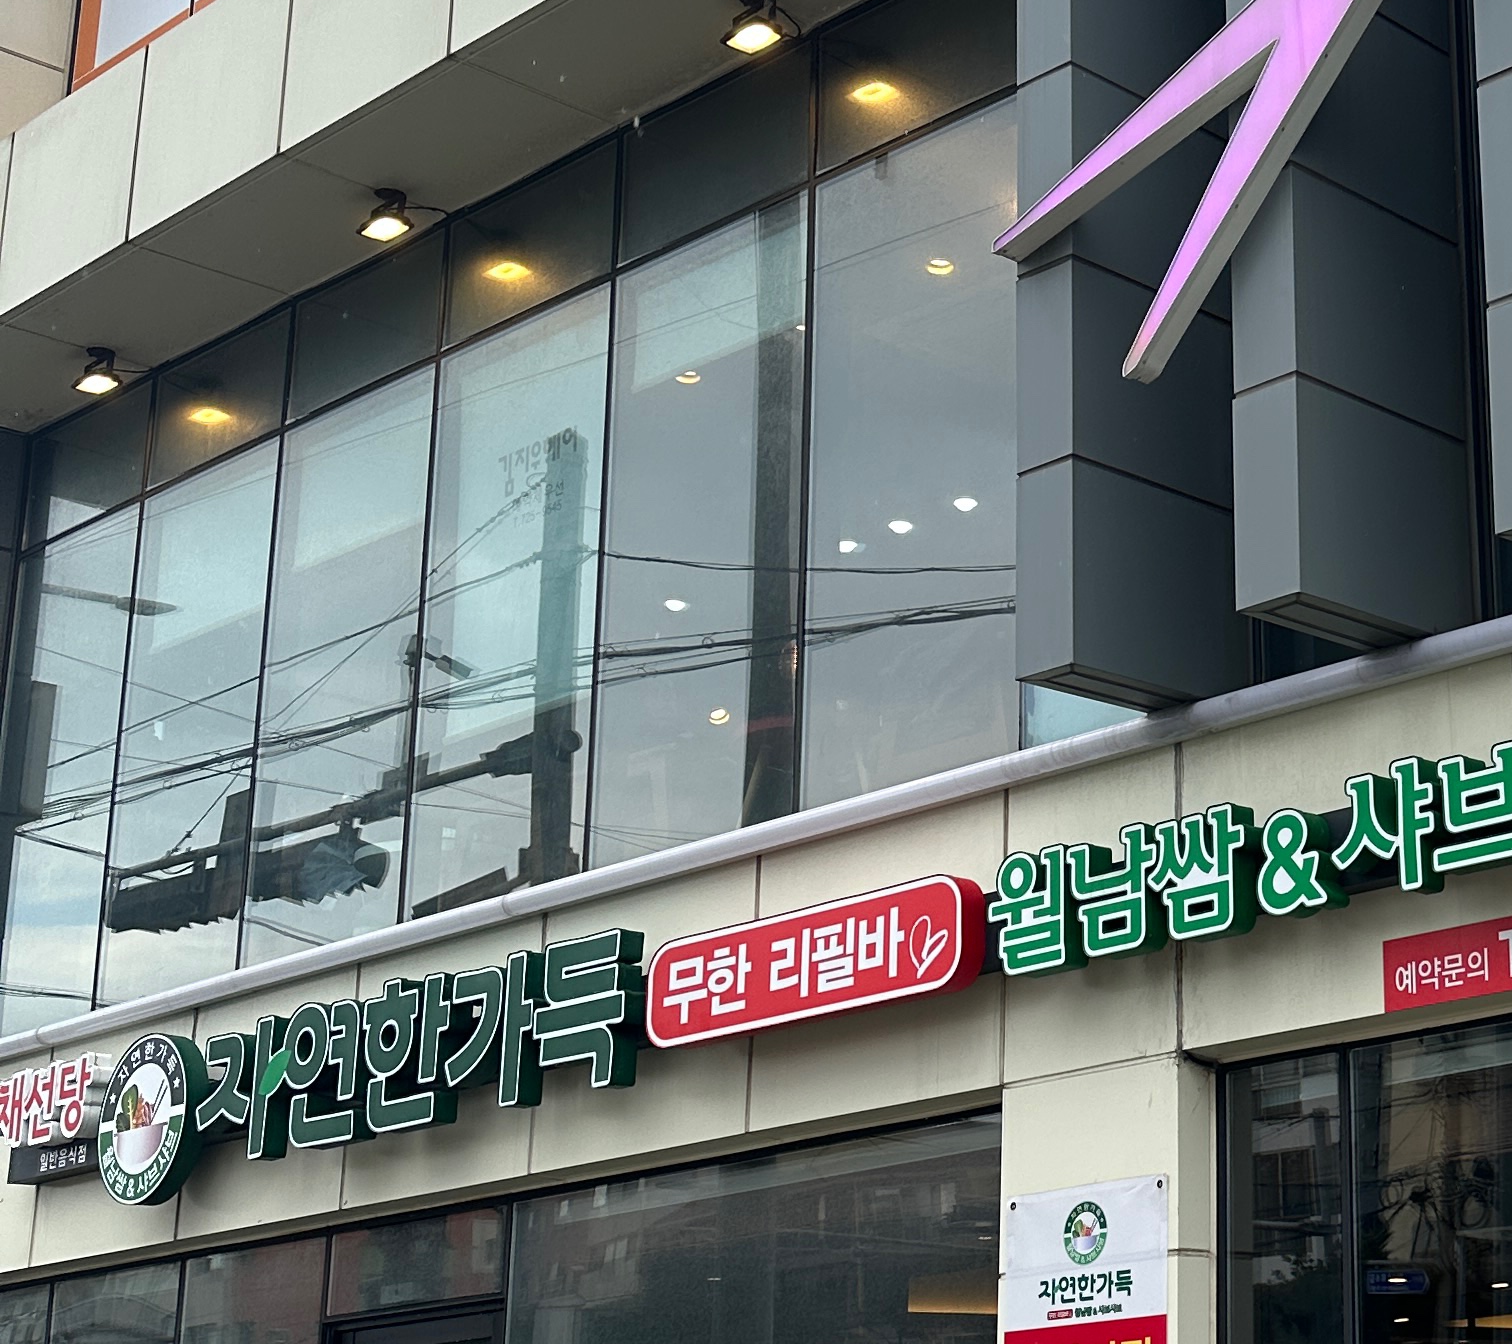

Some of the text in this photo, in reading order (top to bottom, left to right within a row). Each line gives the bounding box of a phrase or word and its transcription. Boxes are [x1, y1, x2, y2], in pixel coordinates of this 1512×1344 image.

[662, 905, 904, 1025] 무한 리필바
[1394, 946, 1490, 996] 예약문의
[117, 1041, 180, 1086] 자연한가득
[195, 927, 627, 1161] 자연한가득
[0, 1056, 93, 1144] 채선당
[1038, 1269, 1133, 1305] 자연한가득
